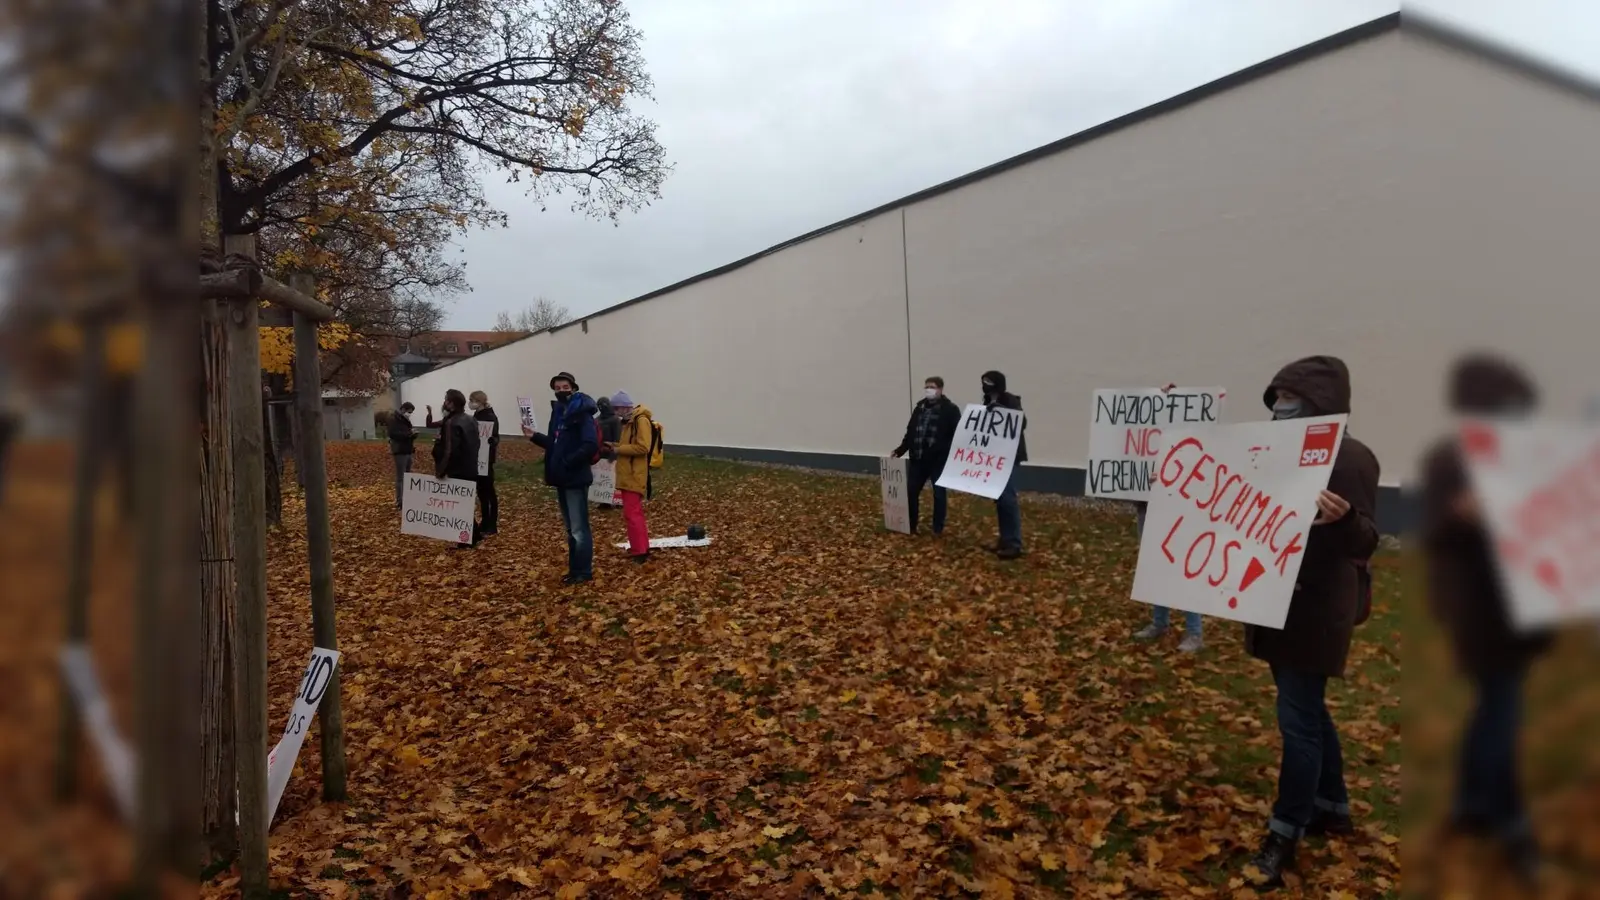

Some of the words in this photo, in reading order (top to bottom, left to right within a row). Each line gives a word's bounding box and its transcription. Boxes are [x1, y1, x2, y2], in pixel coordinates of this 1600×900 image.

[1096, 393, 1216, 425] NAZIOPFER
[964, 409, 1019, 440] HIRN
[969, 434, 990, 447] AN
[953, 447, 1006, 470] MASKE
[1302, 449, 1329, 464] SPD
[410, 478, 474, 497] MITDENKEN
[961, 469, 991, 483] AUF!
[426, 497, 460, 510] STATT
[1160, 437, 1302, 577] GESCHMACK
[406, 508, 472, 532] QUERDENKEN
[1161, 515, 1266, 609] LOS!
[297, 654, 333, 706] ID
[284, 713, 306, 735] OS
